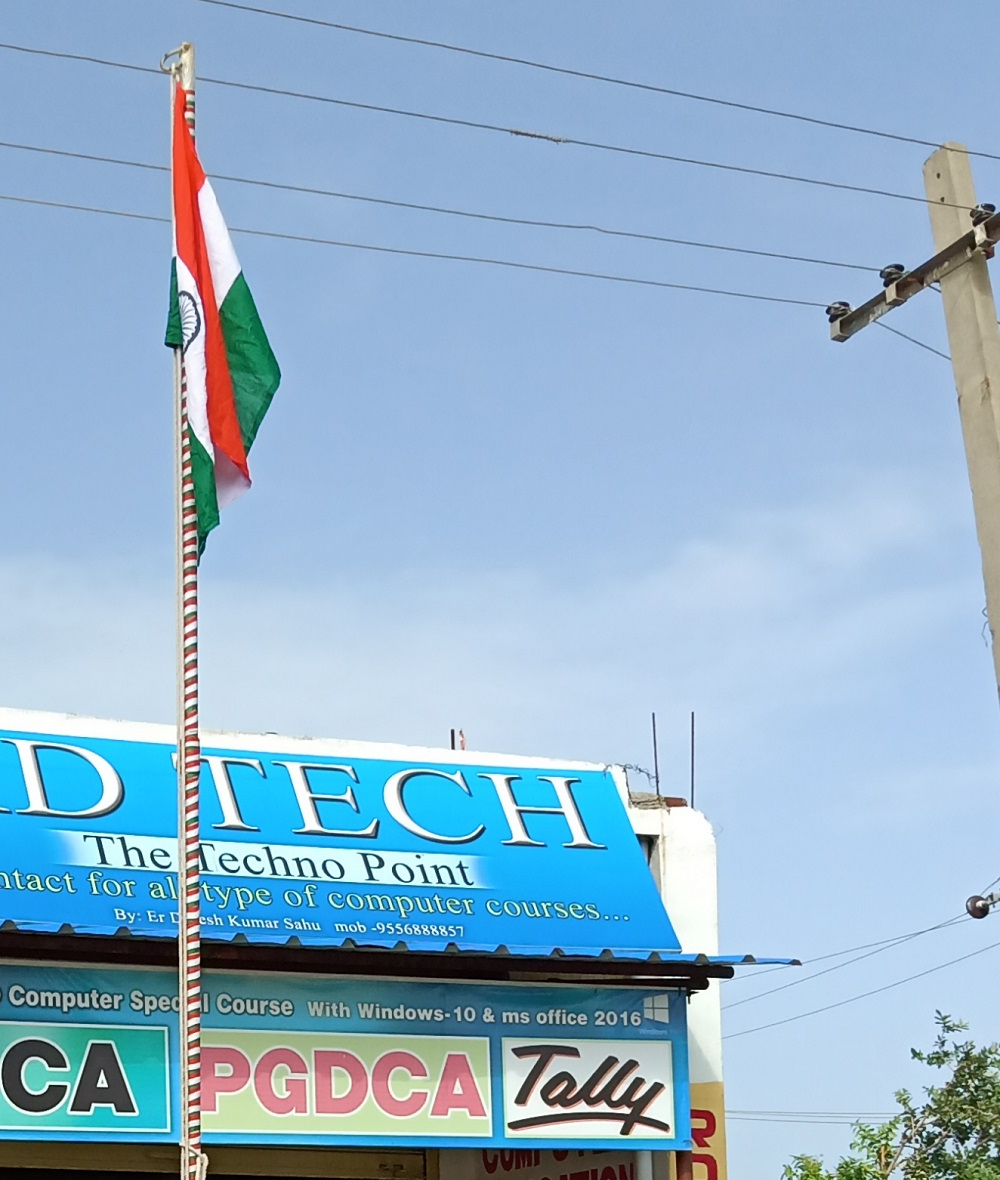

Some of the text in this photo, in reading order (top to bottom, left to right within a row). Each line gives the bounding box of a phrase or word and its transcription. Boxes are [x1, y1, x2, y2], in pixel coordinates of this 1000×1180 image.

[171, 752, 606, 850] TECH
[83, 835, 474, 886] The Techno Point
[87, 871, 136, 897] for
[149, 875, 179, 900] al
[200, 880, 272, 910] type
[284, 884, 318, 907] of
[327, 893, 474, 918] computer
[114, 908, 142, 923] By:
[147, 911, 165, 923] Er
[227, 914, 279, 929] Kumar
[284, 918, 321, 931] Sahu
[335, 922, 366, 933] mob
[8, 985, 123, 1012] Computer
[216, 993, 294, 1017] Course
[306, 1001, 351, 1019] With
[357, 1003, 476, 1023] Windows-10
[482, 1008, 496, 1023] &
[502, 1012, 530, 1025] ms
[536, 1010, 588, 1026] office
[594, 1010, 642, 1027] 2016
[200, 1045, 488, 1119] PGDCA
[508, 1044, 668, 1136] Tally
